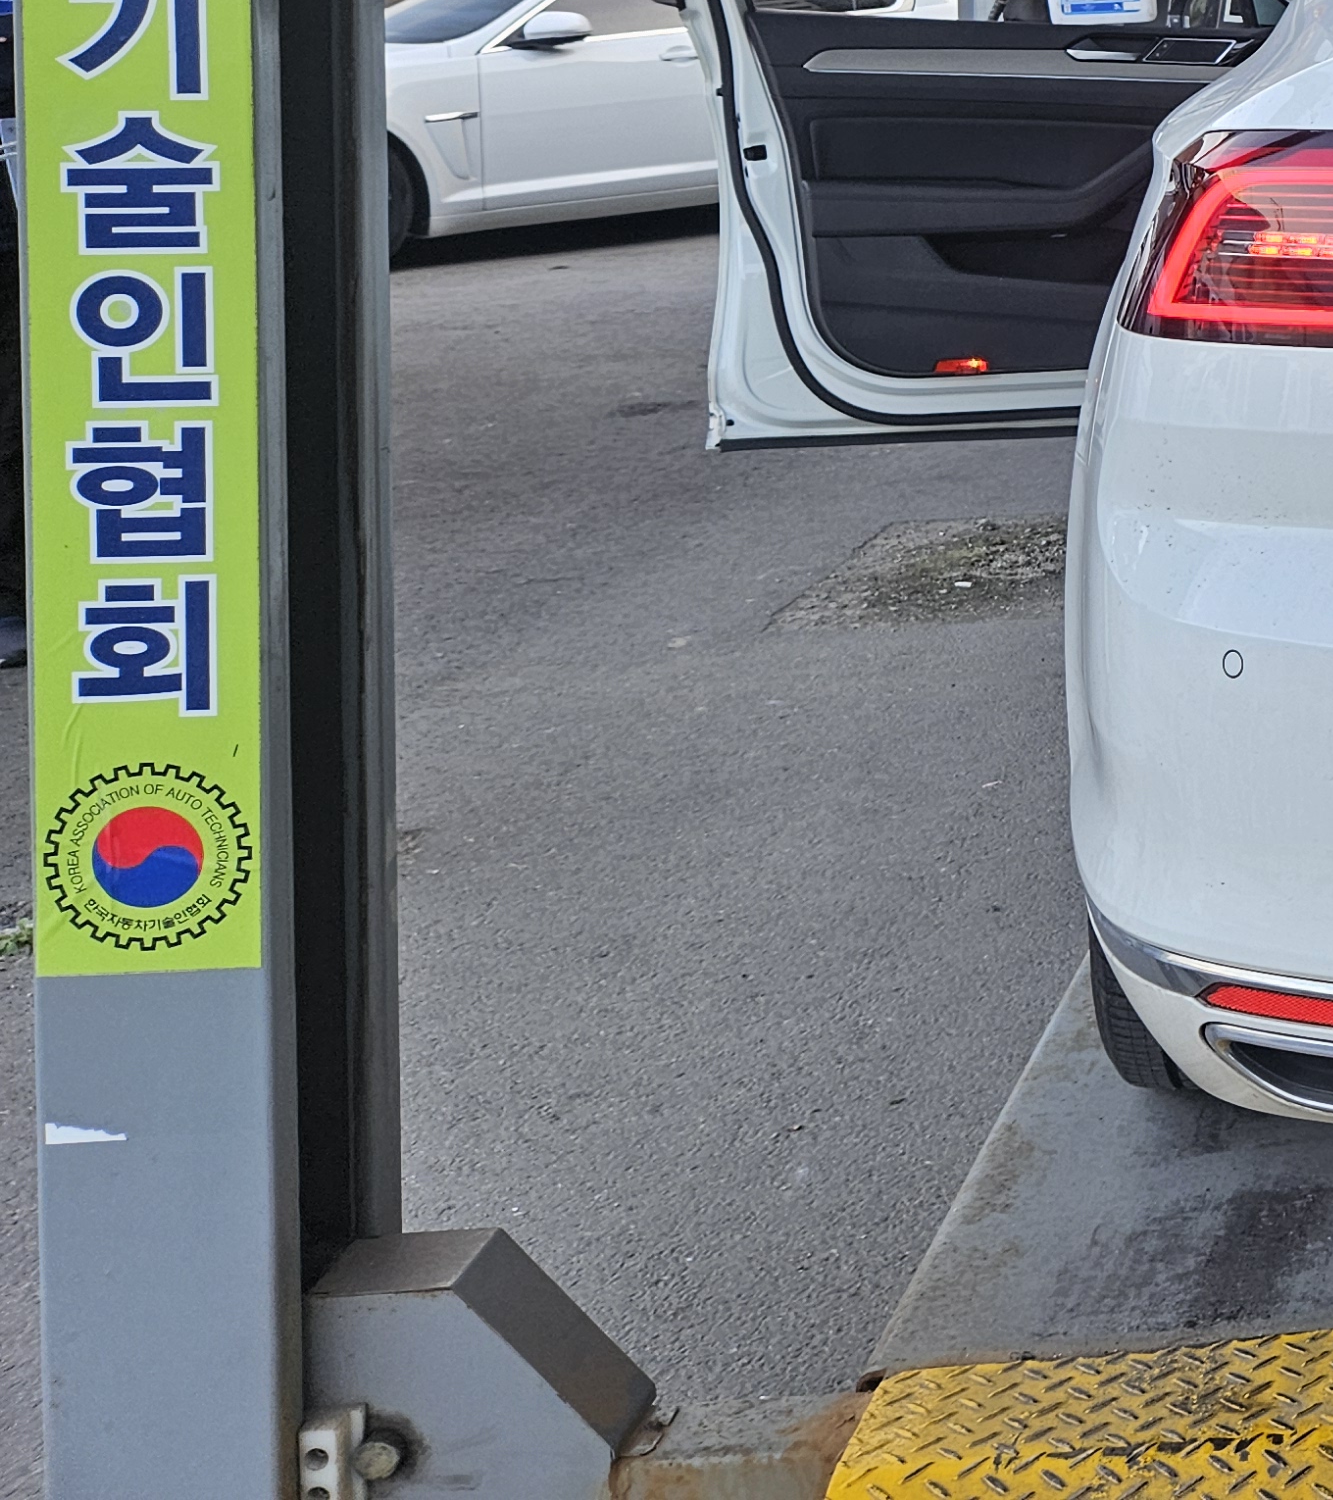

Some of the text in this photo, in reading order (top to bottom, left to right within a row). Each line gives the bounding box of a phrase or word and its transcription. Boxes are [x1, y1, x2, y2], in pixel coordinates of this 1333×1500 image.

[66, 783, 229, 895] KOREA ASSOCIATION OF AUTO TECHNICIANS
[84, 893, 213, 932] 한국자동차기술인협회
